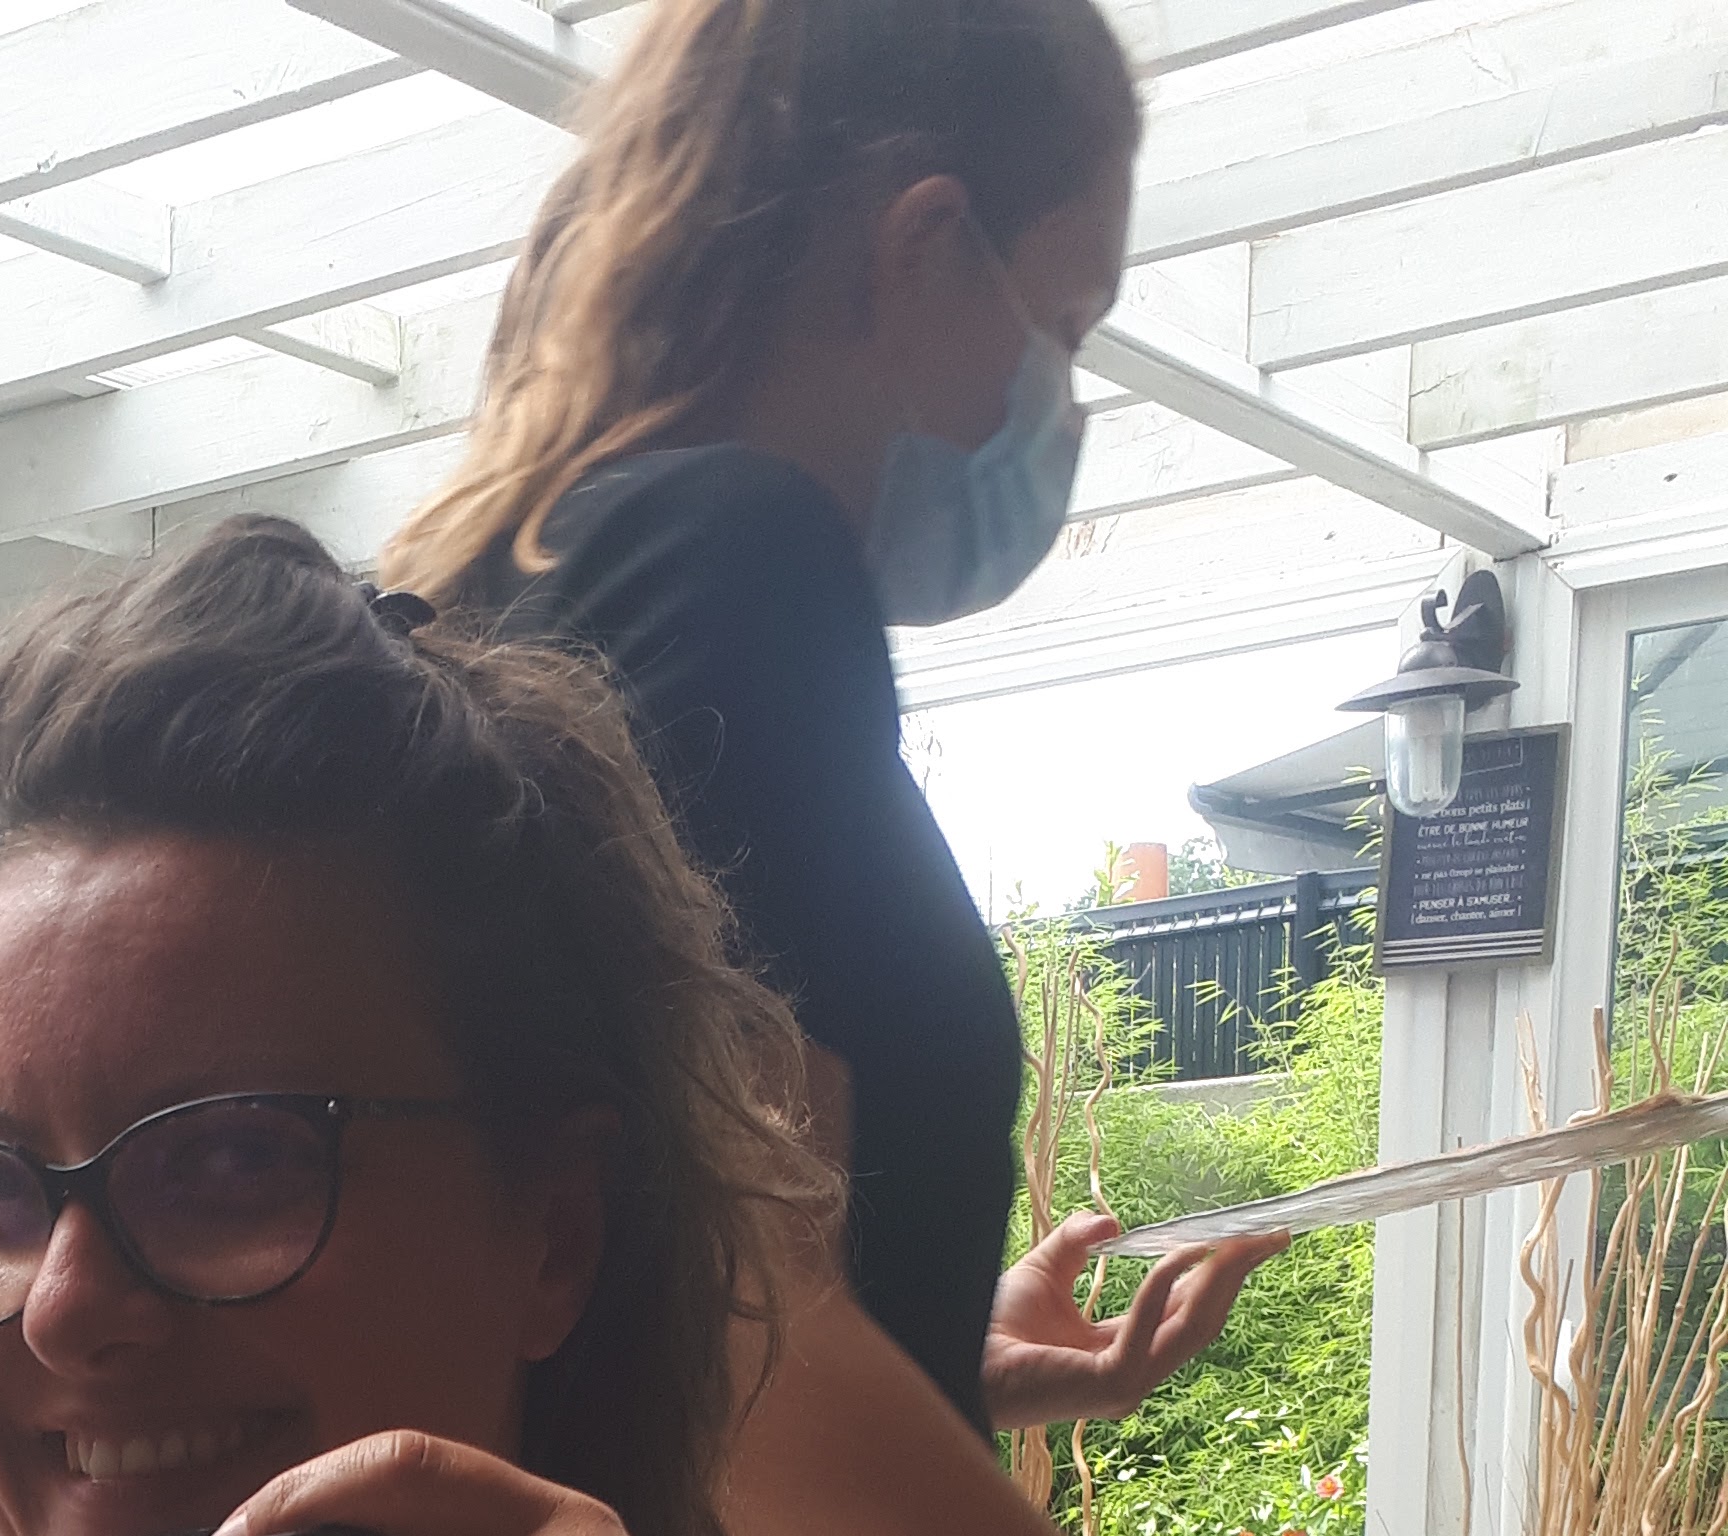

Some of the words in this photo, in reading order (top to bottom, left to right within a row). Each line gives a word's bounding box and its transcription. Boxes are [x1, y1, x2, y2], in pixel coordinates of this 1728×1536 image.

[1468, 802, 1498, 817] petits
[1500, 799, 1525, 814] plats
[1444, 824, 1455, 835] DE
[1459, 821, 1489, 833] BONNE
[1492, 817, 1529, 830] HUMEUR
[1433, 871, 1448, 880] pas
[1420, 898, 1456, 910] PENSER
[1450, 911, 1486, 921] chanter,
